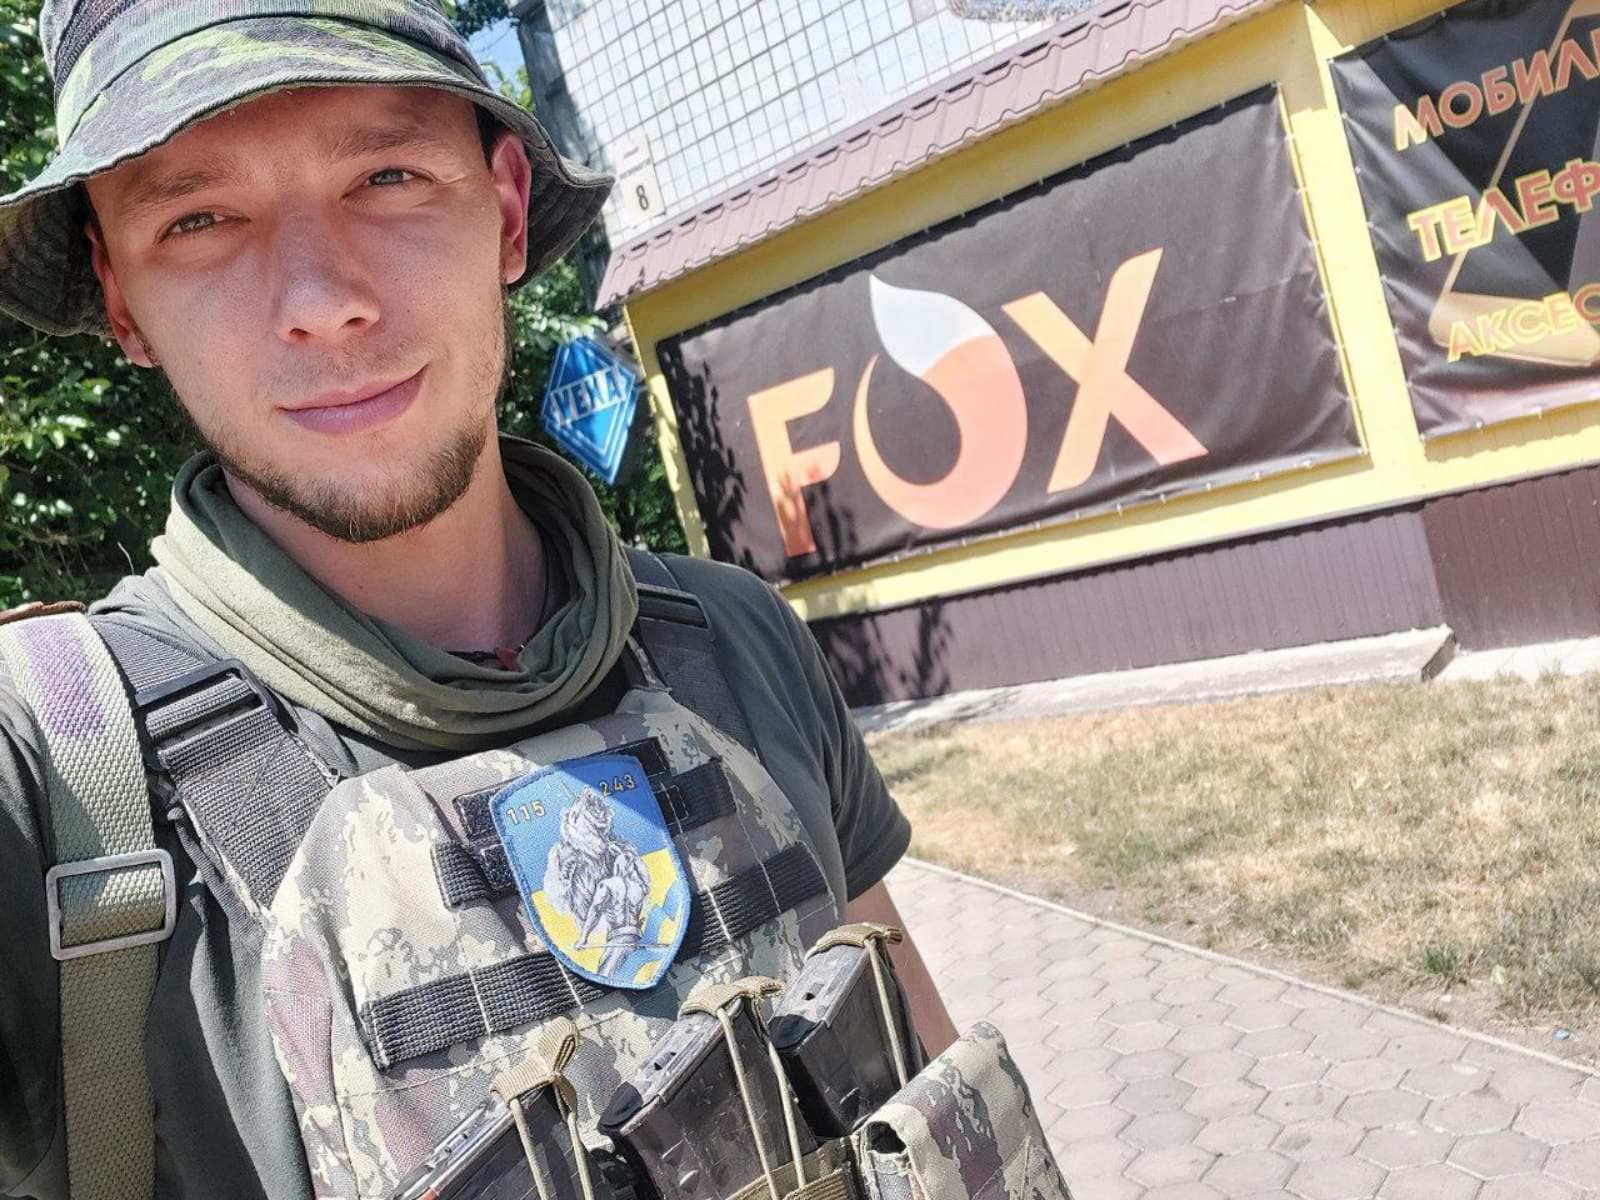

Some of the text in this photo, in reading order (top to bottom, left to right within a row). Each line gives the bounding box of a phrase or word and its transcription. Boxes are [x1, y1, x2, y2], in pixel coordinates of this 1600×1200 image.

[636, 184, 650, 211] 8
[1407, 157, 1600, 262] ТЕЛЕФ
[747, 247, 1208, 557] FOX
[507, 773, 637, 826] 115 243
